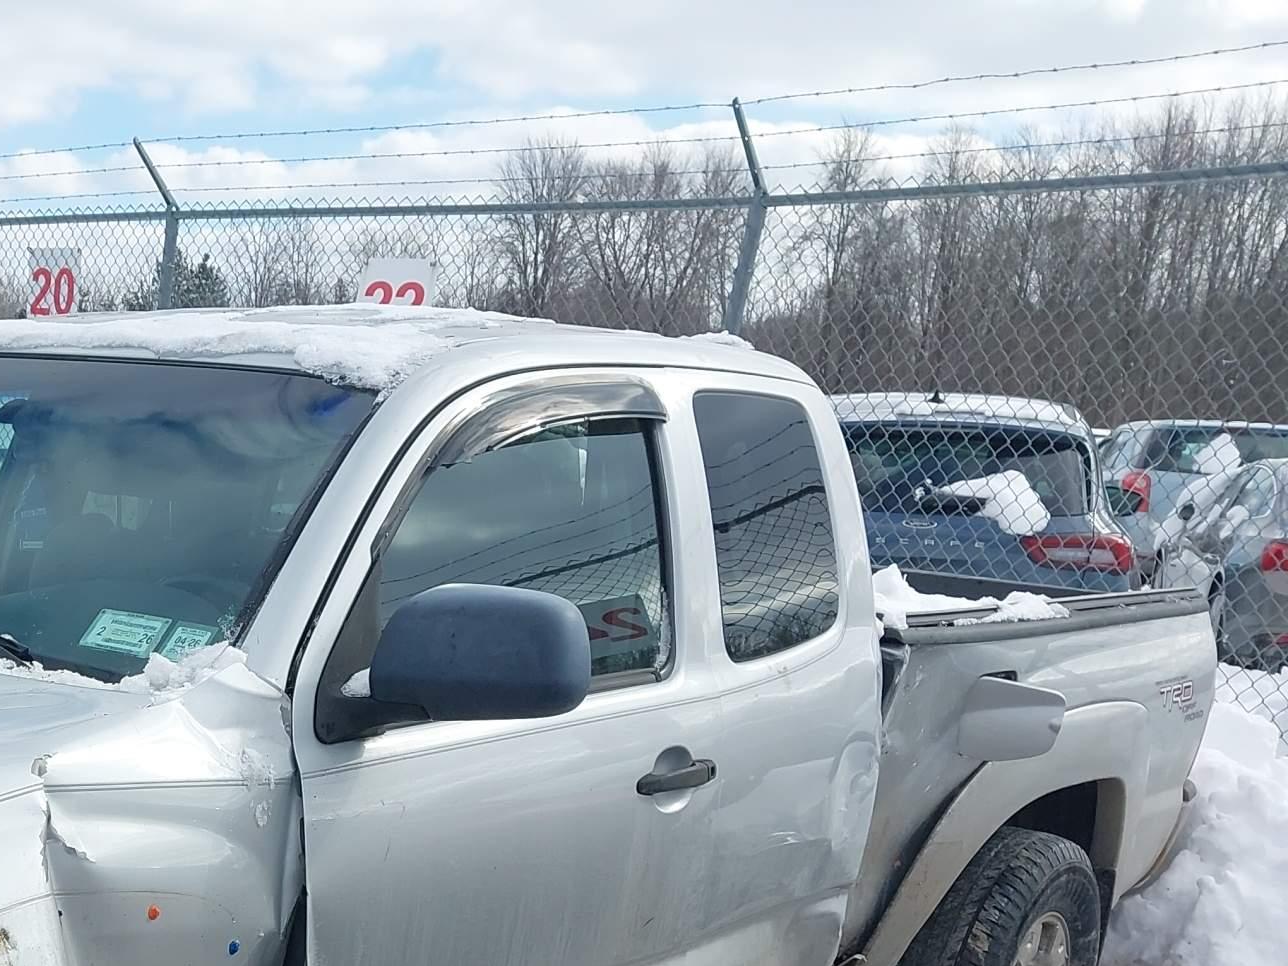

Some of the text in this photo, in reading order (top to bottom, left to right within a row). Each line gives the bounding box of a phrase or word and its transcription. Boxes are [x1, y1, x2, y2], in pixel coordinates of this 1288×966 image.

[30, 267, 75, 316] 20
[96, 626, 107, 637] 2
[137, 633, 155, 645] 26
[1159, 680, 1194, 713] TRD
